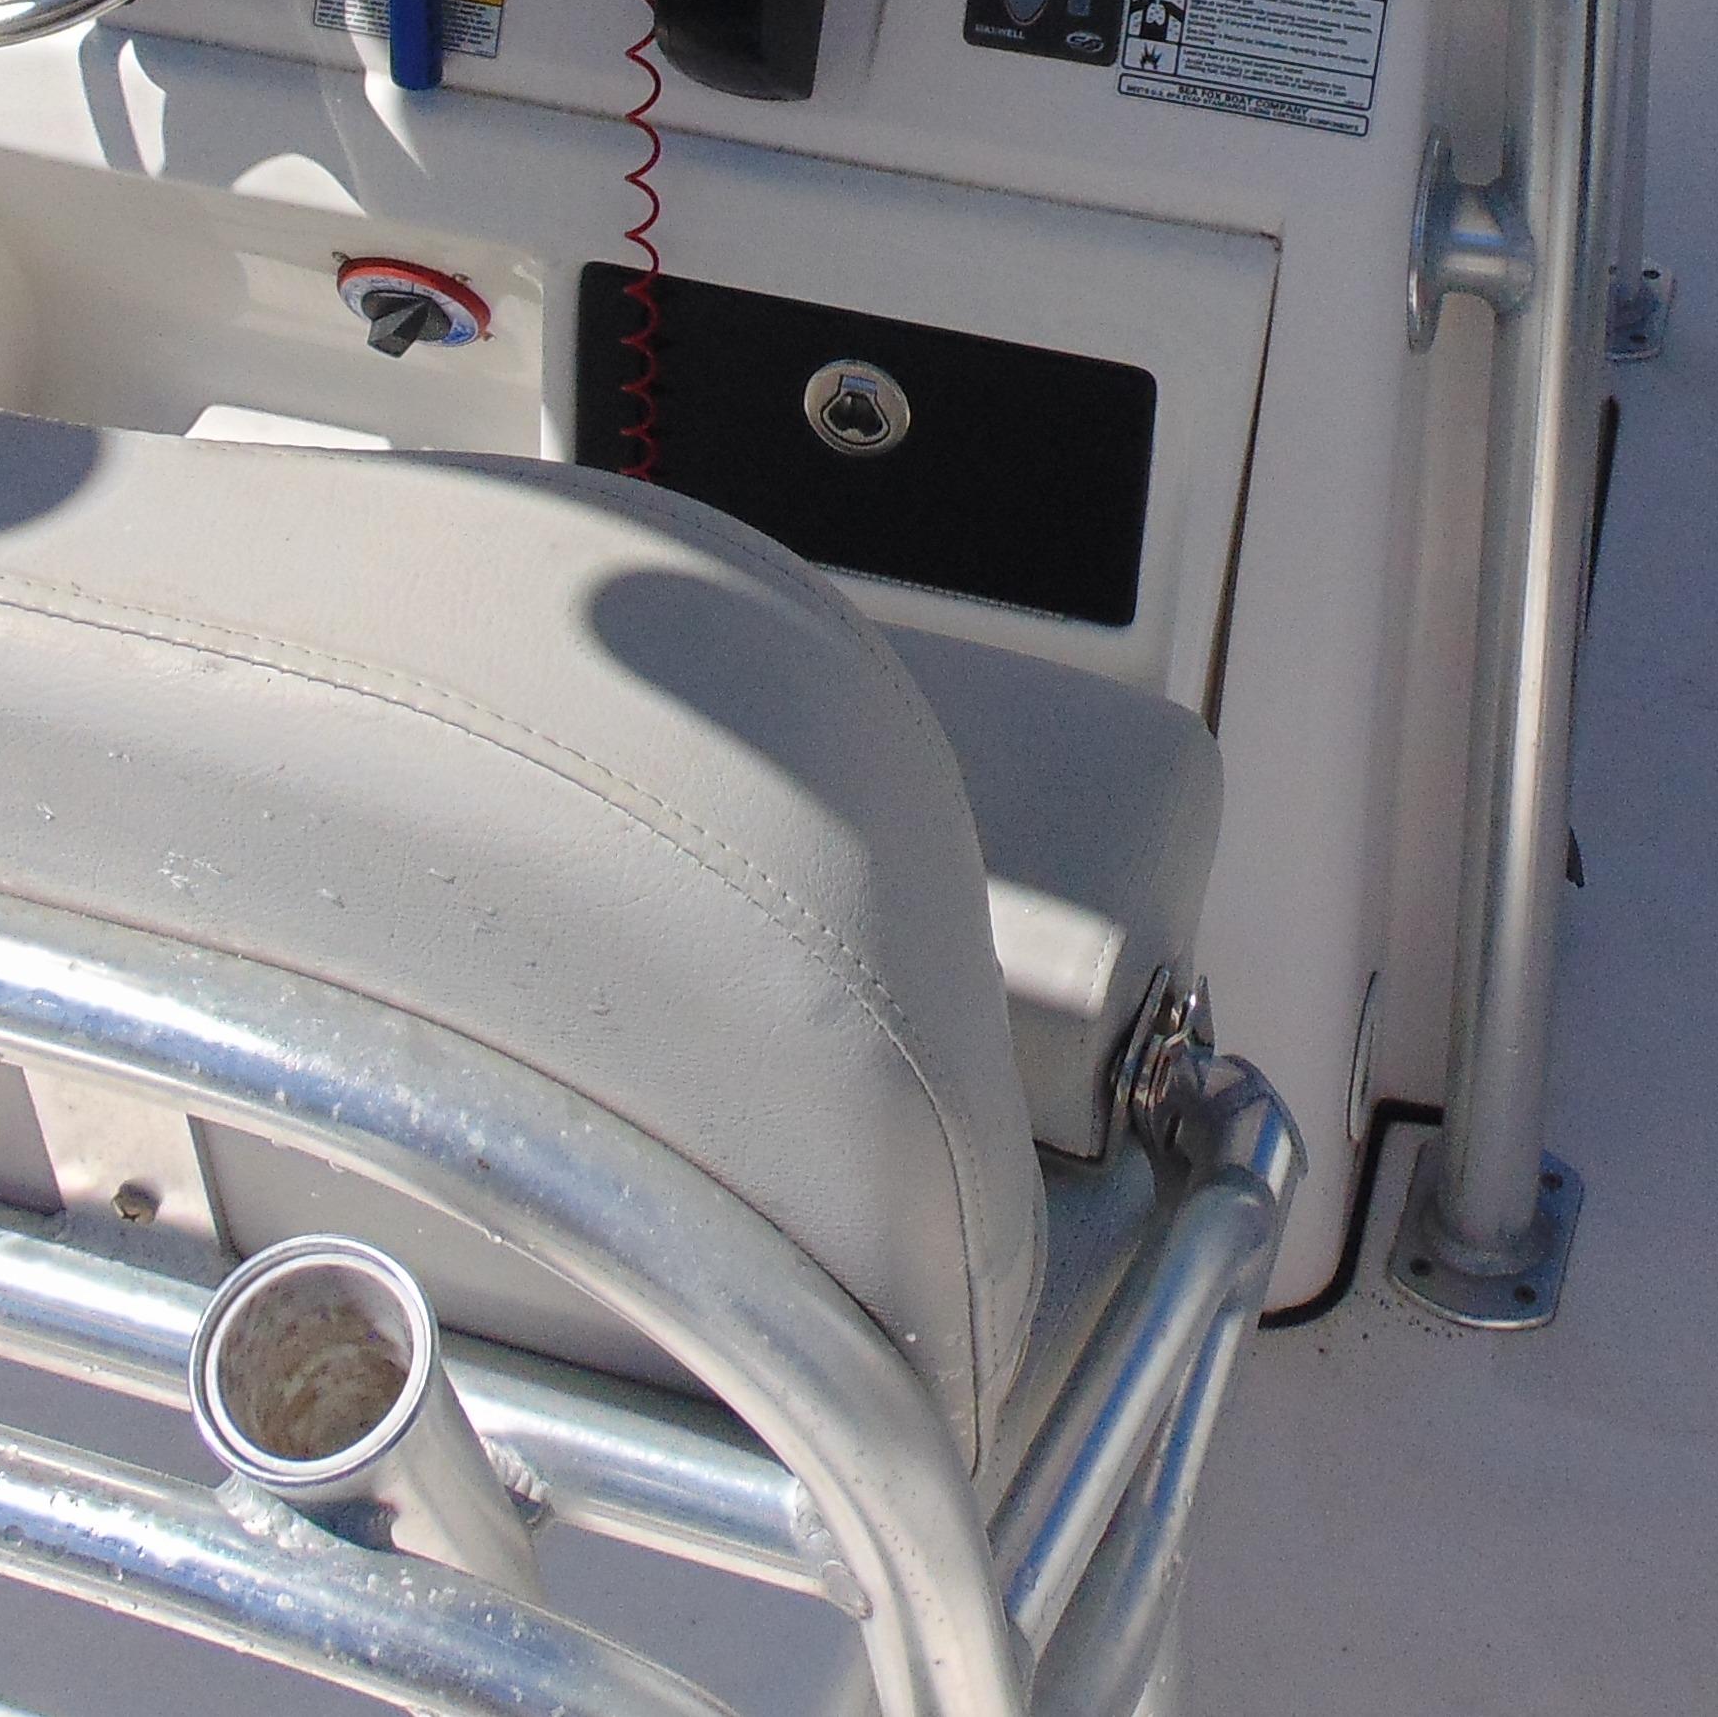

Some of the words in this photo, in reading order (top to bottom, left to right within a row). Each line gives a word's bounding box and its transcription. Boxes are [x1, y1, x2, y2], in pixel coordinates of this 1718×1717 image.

[1201, 89, 1221, 102] FOX
[1224, 92, 1253, 105] BOAT
[1255, 97, 1310, 116] COMPANY
